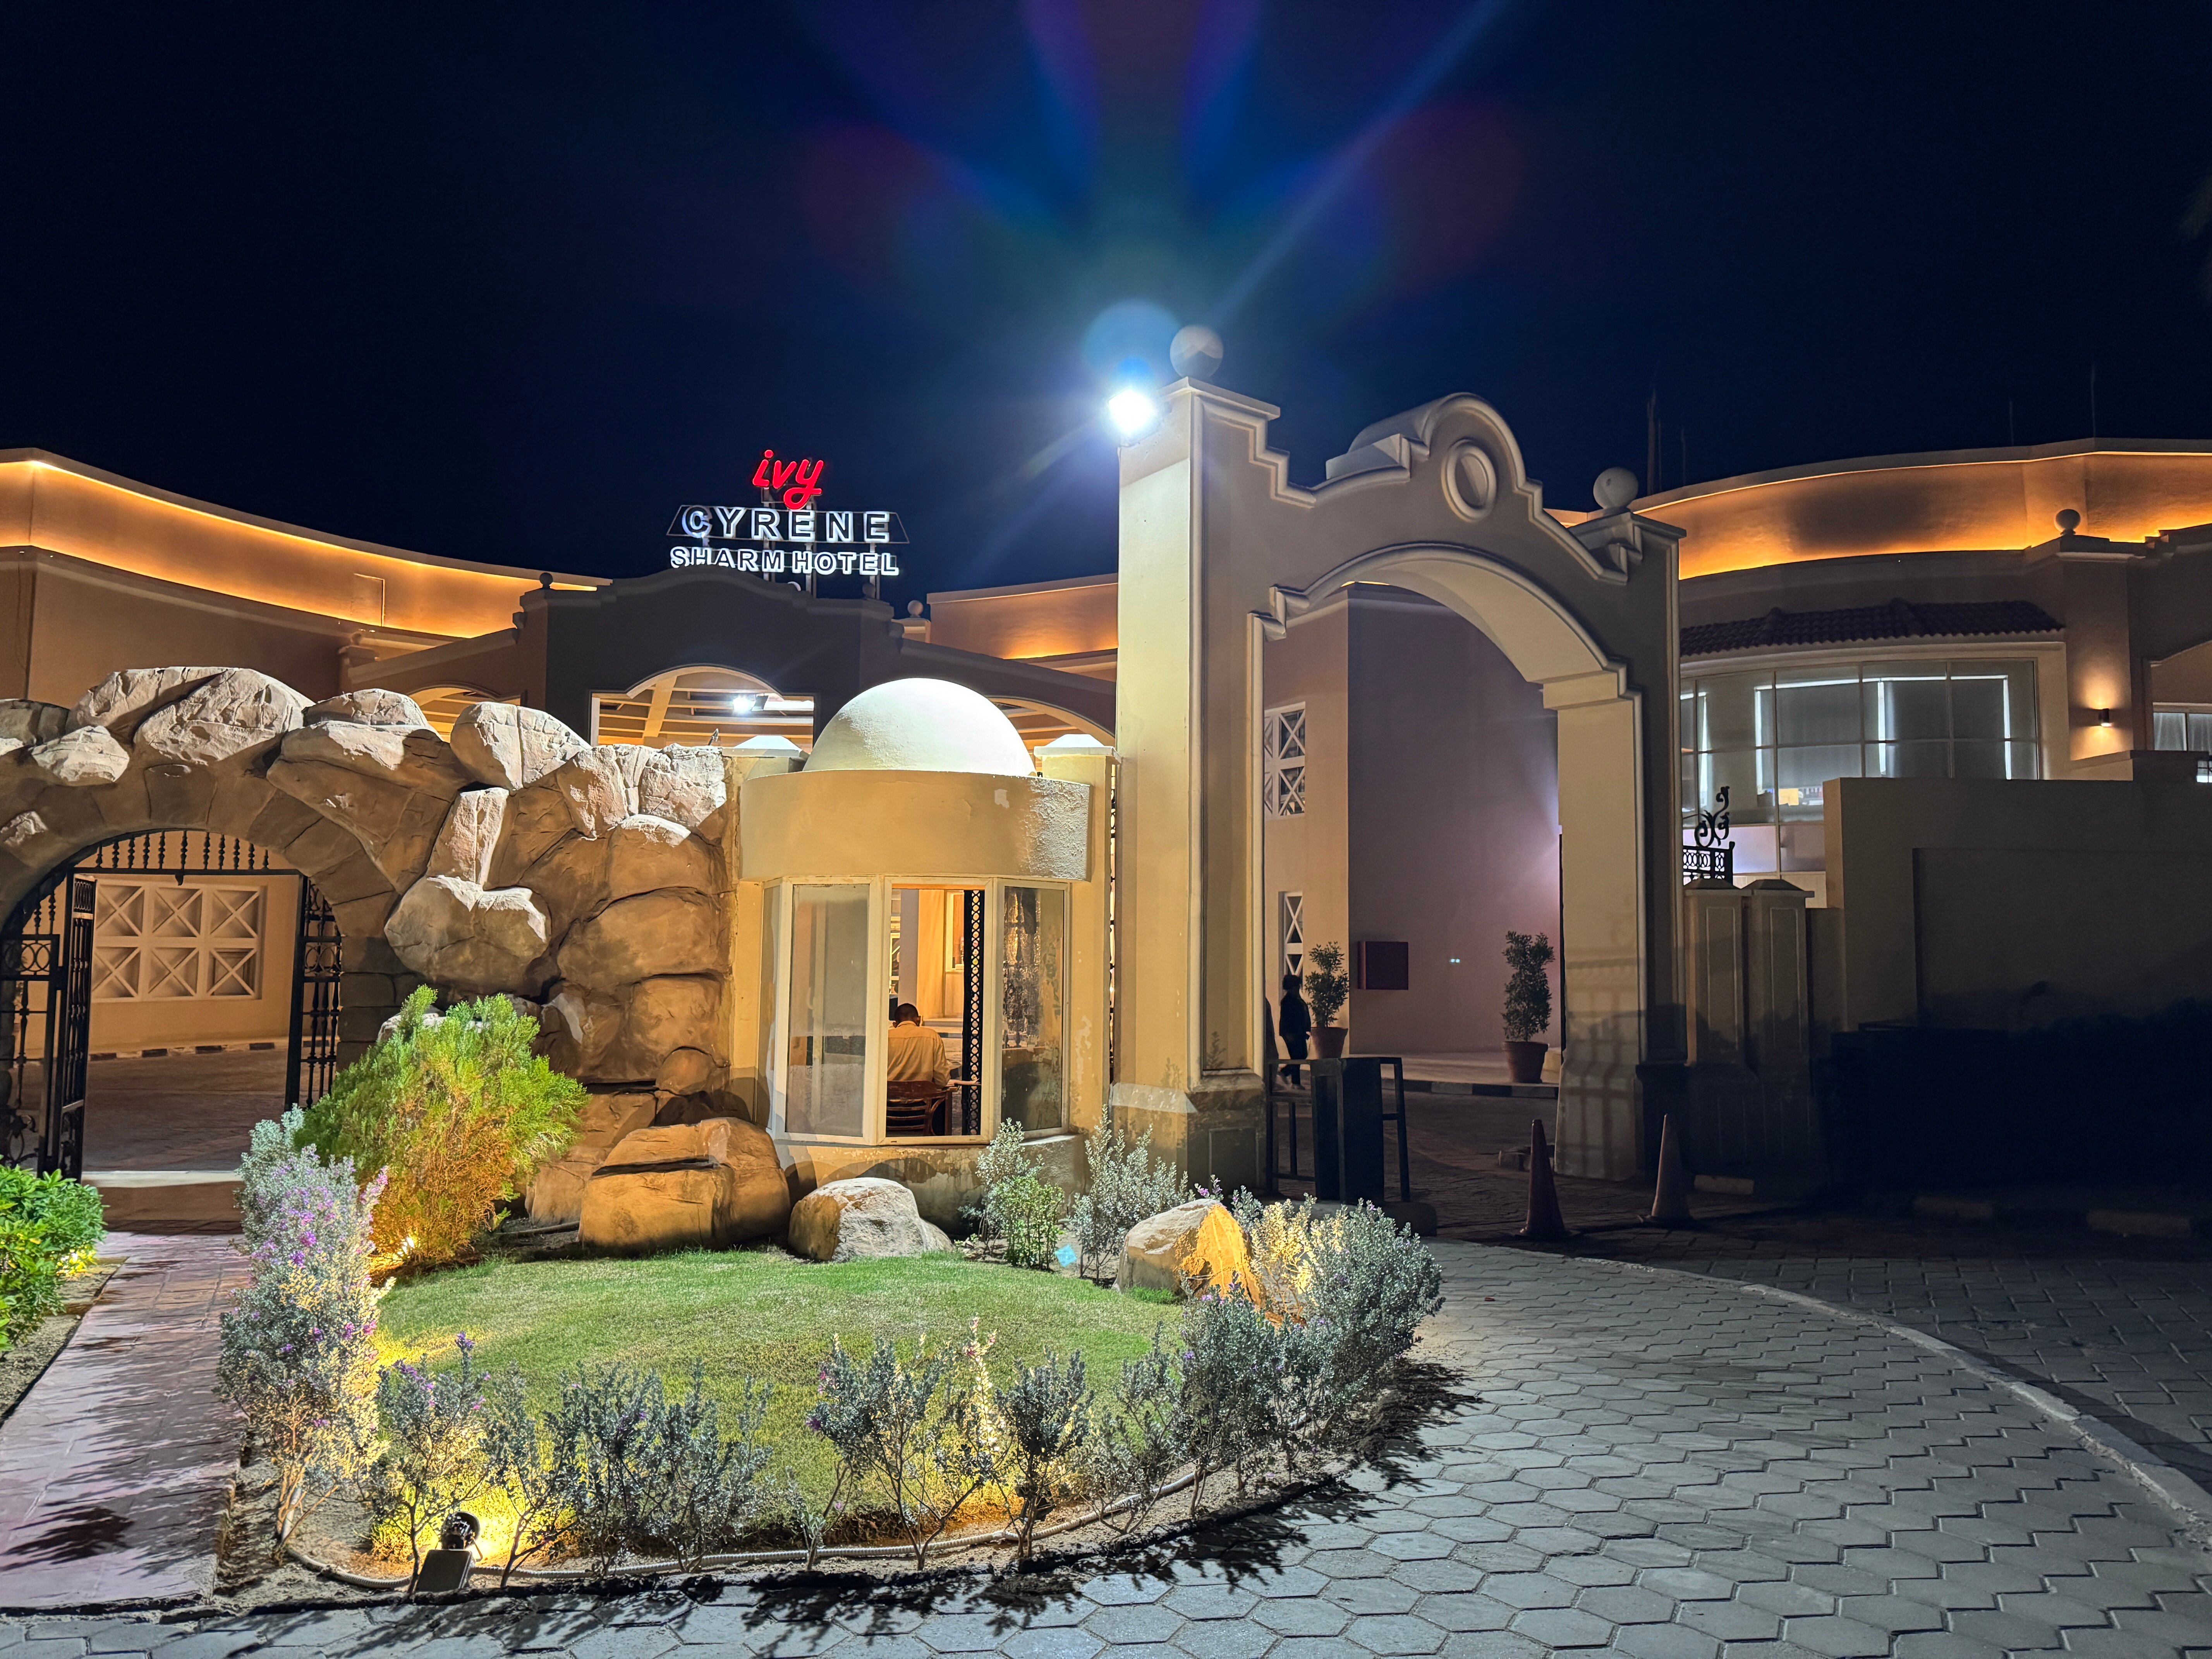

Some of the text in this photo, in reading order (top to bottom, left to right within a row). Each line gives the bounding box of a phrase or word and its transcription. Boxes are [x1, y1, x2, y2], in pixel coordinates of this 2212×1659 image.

[752, 449, 824, 510] ivy
[682, 505, 890, 543] CYRENE
[670, 546, 899, 575] SHARM HOTEL
